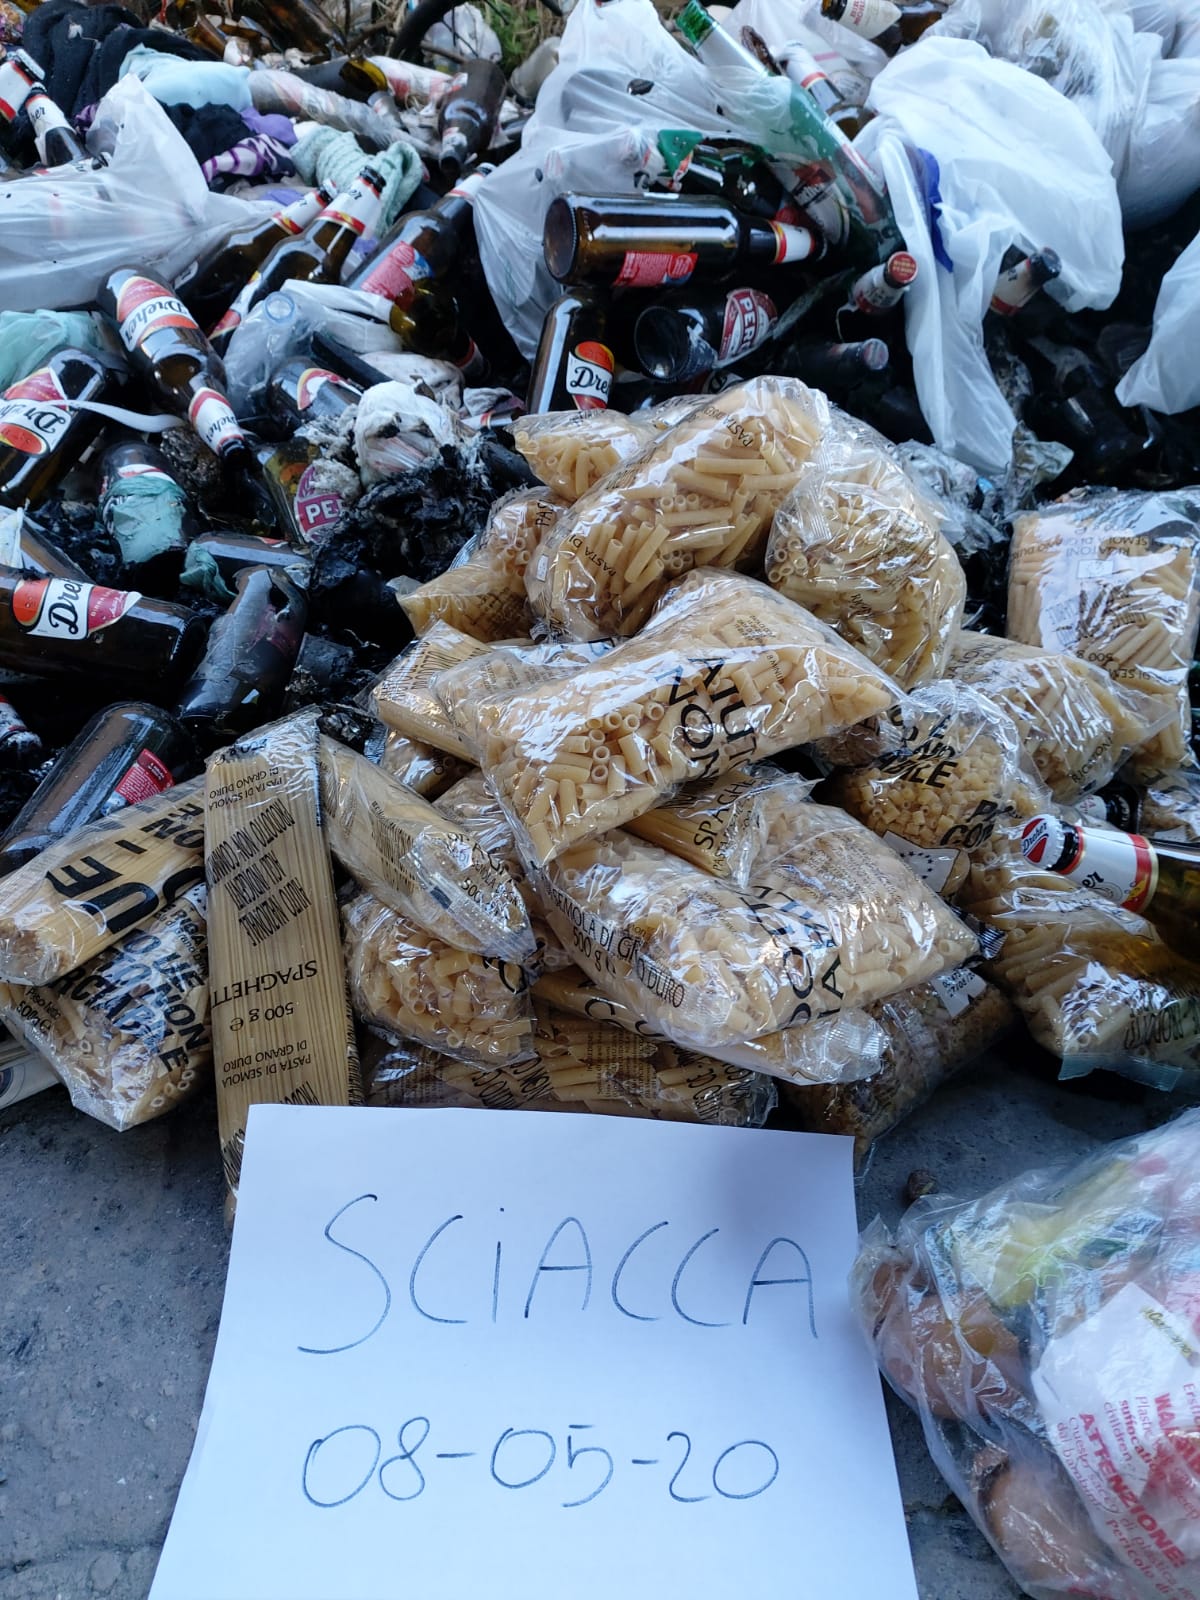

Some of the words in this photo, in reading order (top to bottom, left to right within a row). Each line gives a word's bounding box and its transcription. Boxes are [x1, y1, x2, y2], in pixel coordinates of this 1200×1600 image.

[127, 300, 187, 343] Dreher
[569, 534, 583, 549] DI
[584, 547, 616, 577] PASTA
[237, 770, 267, 787] GRANO
[209, 784, 235, 799] DURO
[249, 797, 295, 847] PRODOTTO
[1022, 822, 1049, 851] Dreher
[248, 1008, 260, 1023] g
[264, 1002, 295, 1021] 500
[255, 1045, 295, 1062] GRANO
[297, 1040, 307, 1050] DI
[223, 1056, 253, 1073] DURO
[265, 1066, 277, 1076] DI
[280, 1054, 312, 1072] PASTA
[221, 1069, 263, 1089] SEMOLA
[302, 1416, 779, 1508] 08-05-20
